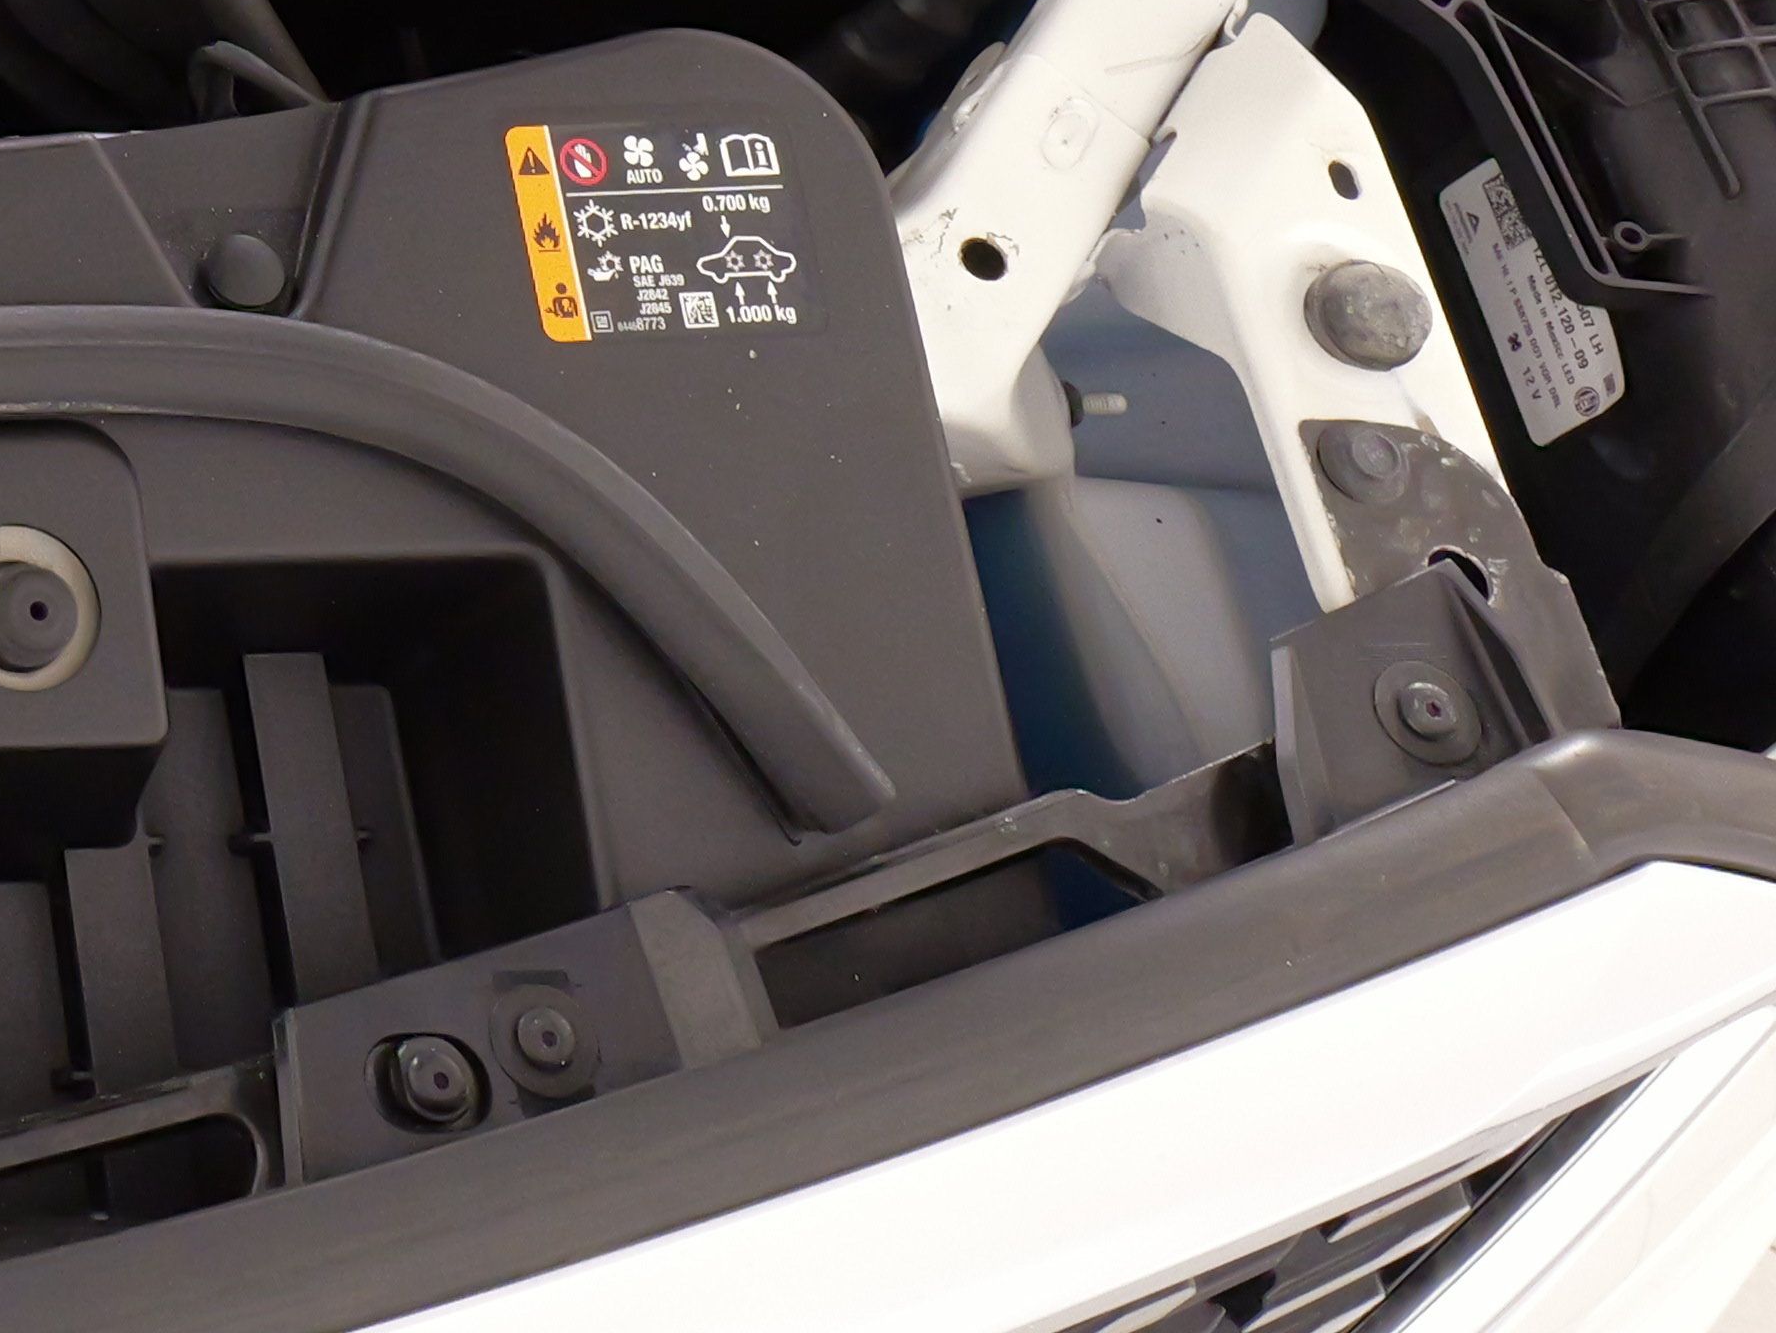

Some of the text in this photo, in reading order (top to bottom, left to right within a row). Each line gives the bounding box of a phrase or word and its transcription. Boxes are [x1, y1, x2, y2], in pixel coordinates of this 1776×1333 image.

[626, 168, 663, 184] AUTO
[702, 193, 771, 214] 0.700 kg
[620, 210, 692, 232] R-1234yf
[629, 254, 665, 274] PAG
[632, 273, 685, 288] SAE J639
[726, 304, 798, 325] 1.000 kg
[1527, 275, 1543, 305] Made
[1561, 363, 1576, 385] LED
[1589, 334, 1605, 356] LH
[1522, 367, 1543, 401] 12 V
